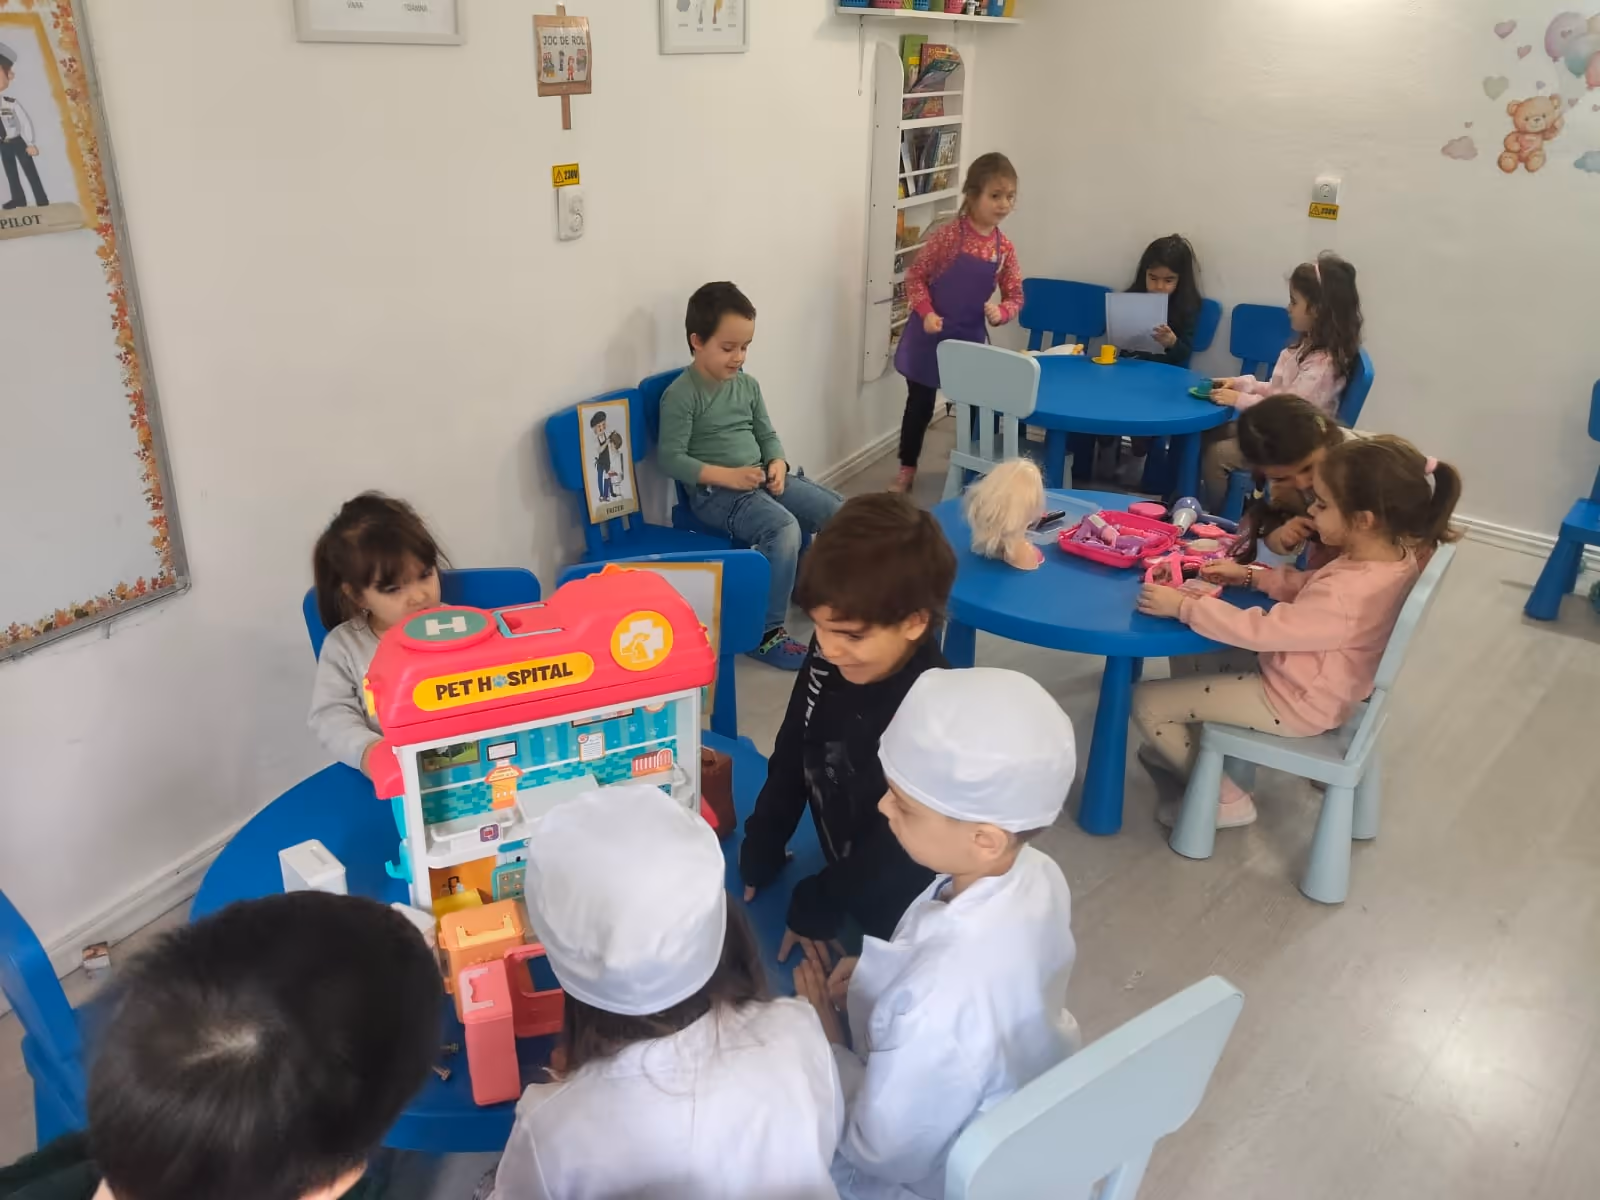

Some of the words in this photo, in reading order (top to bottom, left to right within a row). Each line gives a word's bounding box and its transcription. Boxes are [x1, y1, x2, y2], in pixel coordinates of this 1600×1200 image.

[542, 35, 558, 46] JOC
[559, 35, 570, 46] DE
[571, 35, 586, 46] ROL
[0, 214, 42, 229] PILOT
[606, 504, 625, 516] FRIZER
[435, 678, 473, 701] PET
